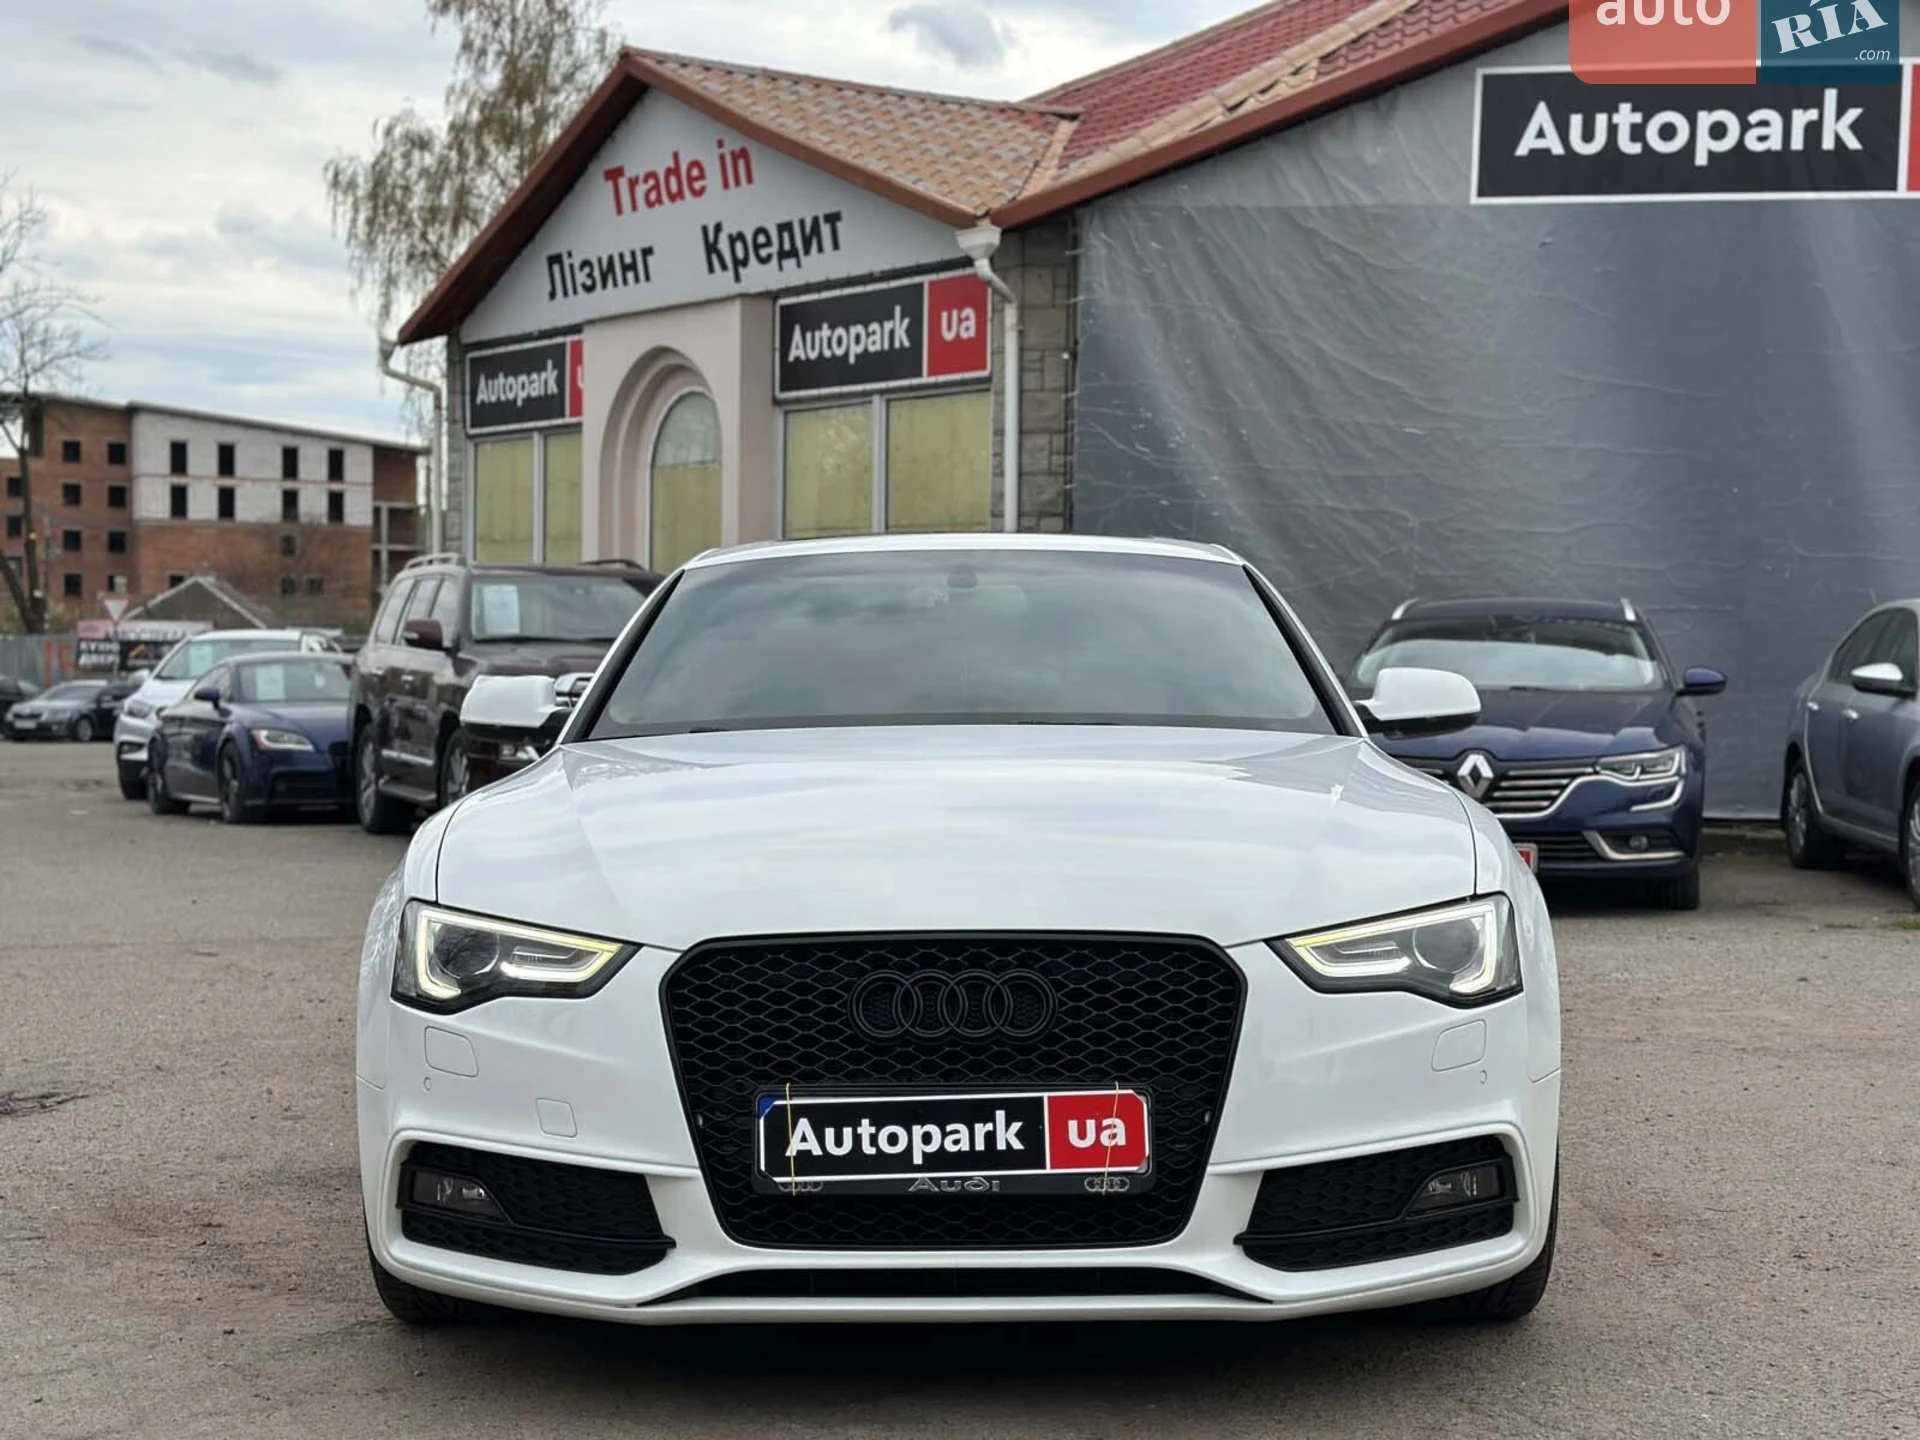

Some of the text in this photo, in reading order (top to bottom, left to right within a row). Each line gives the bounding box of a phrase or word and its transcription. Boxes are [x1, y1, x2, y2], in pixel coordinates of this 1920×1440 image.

[1514, 88, 1864, 167] Autopark
[603, 138, 754, 216] Trade in
[546, 210, 843, 301] Лізинг Кредит
[787, 304, 977, 365] Autopark ua
[475, 359, 559, 407] Autopark
[785, 1109, 1126, 1164] Autopark ua
[908, 1176, 1000, 1192] Audi
